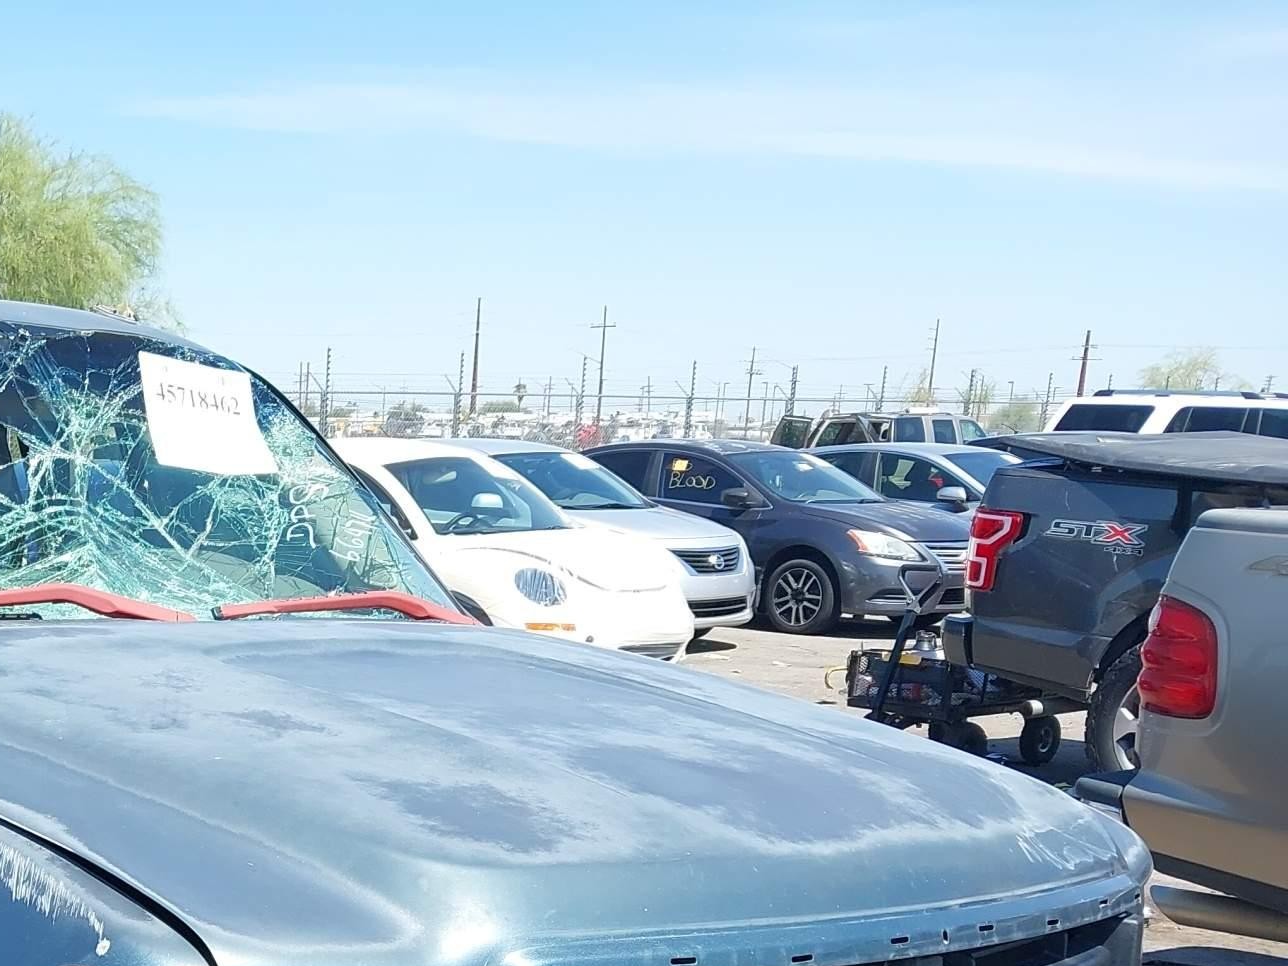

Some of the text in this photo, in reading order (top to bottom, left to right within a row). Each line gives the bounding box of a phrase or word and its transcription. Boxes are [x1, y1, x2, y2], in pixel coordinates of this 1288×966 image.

[156, 382, 241, 416] 45718462
[669, 471, 716, 489] BLOOD
[1043, 519, 1149, 548] STX
